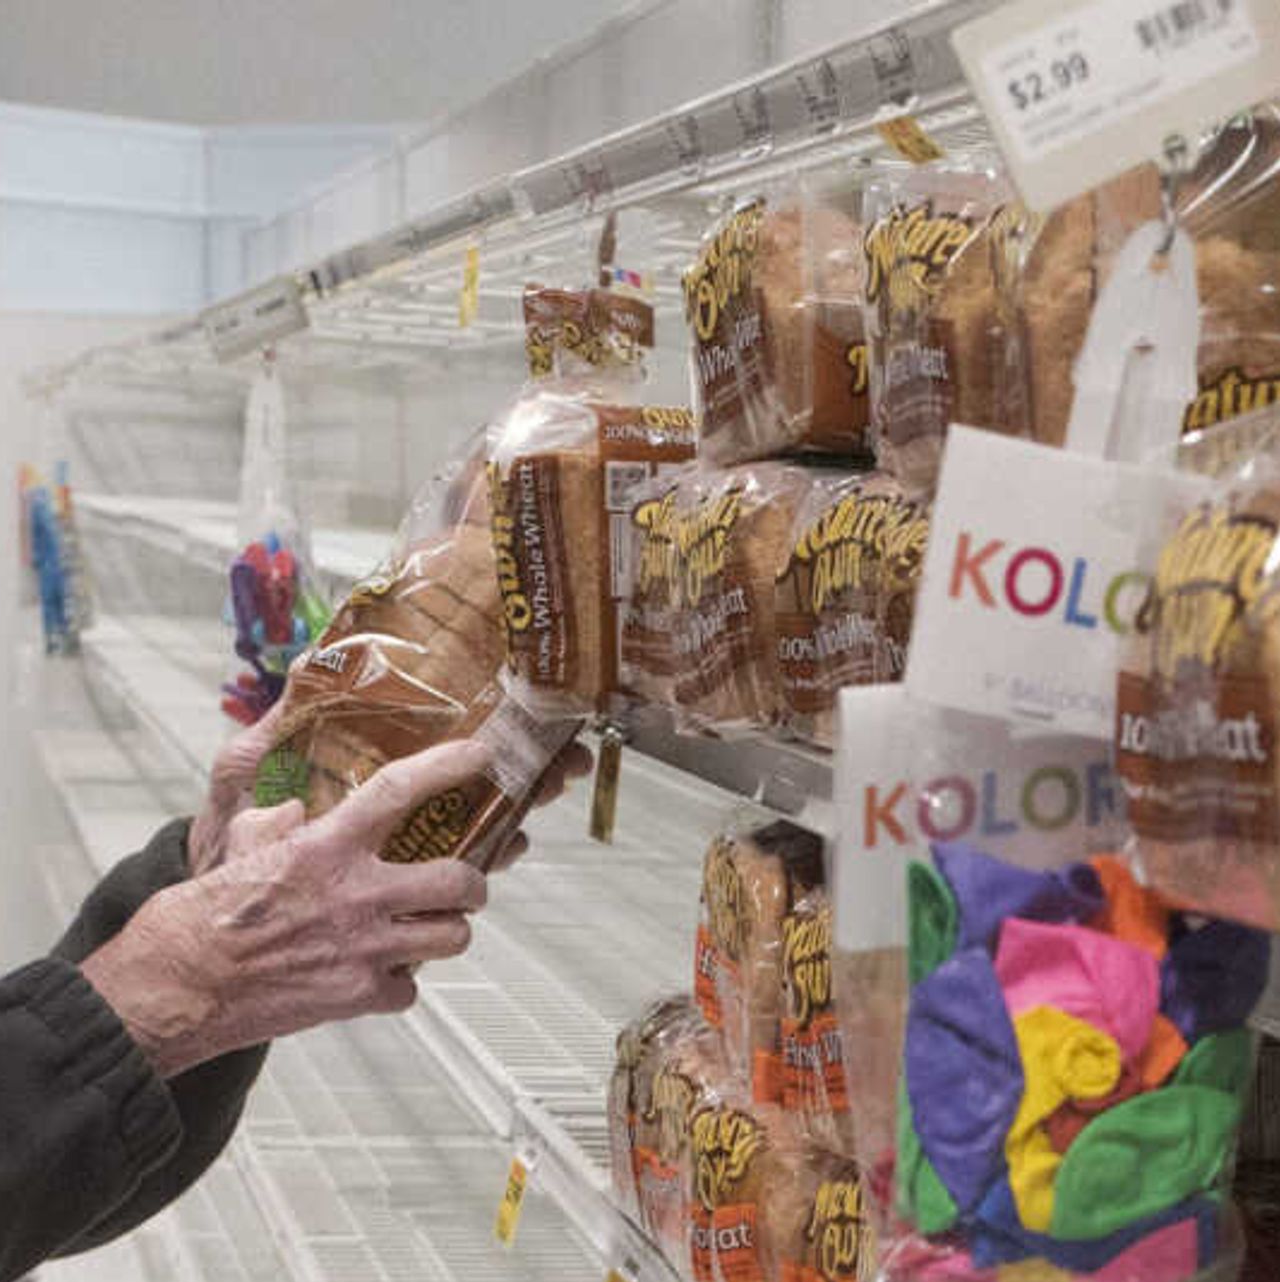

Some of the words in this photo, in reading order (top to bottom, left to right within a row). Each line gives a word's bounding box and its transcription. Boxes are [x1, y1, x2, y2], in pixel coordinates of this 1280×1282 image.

[1007, 51, 1090, 112] $2.99
[519, 462, 541, 546] Wheat
[529, 549, 552, 629] Whole
